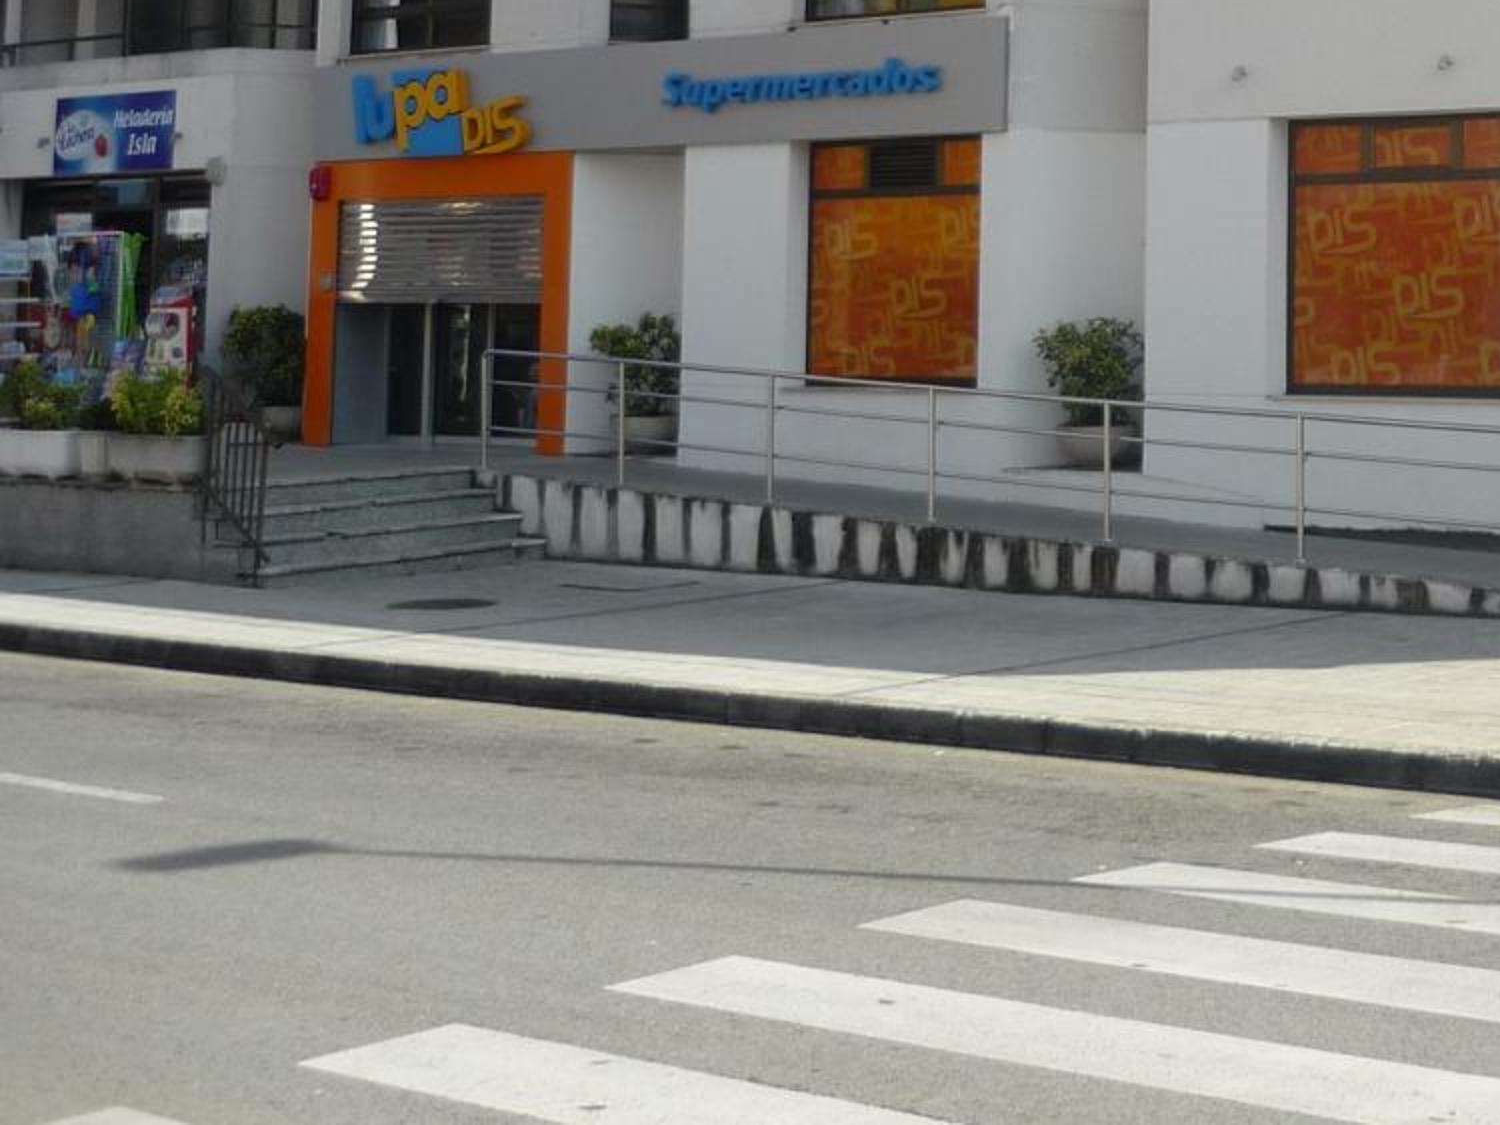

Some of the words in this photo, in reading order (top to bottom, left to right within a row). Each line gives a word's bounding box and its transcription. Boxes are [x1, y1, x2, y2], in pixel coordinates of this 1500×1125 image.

[662, 56, 942, 113] Supermercados
[127, 133, 158, 156] Isla
[462, 94, 533, 155] DIS
[823, 218, 882, 260] DIS
[1307, 204, 1383, 255] DIS
[890, 274, 952, 318] DIS
[1393, 267, 1470, 319] DIS
